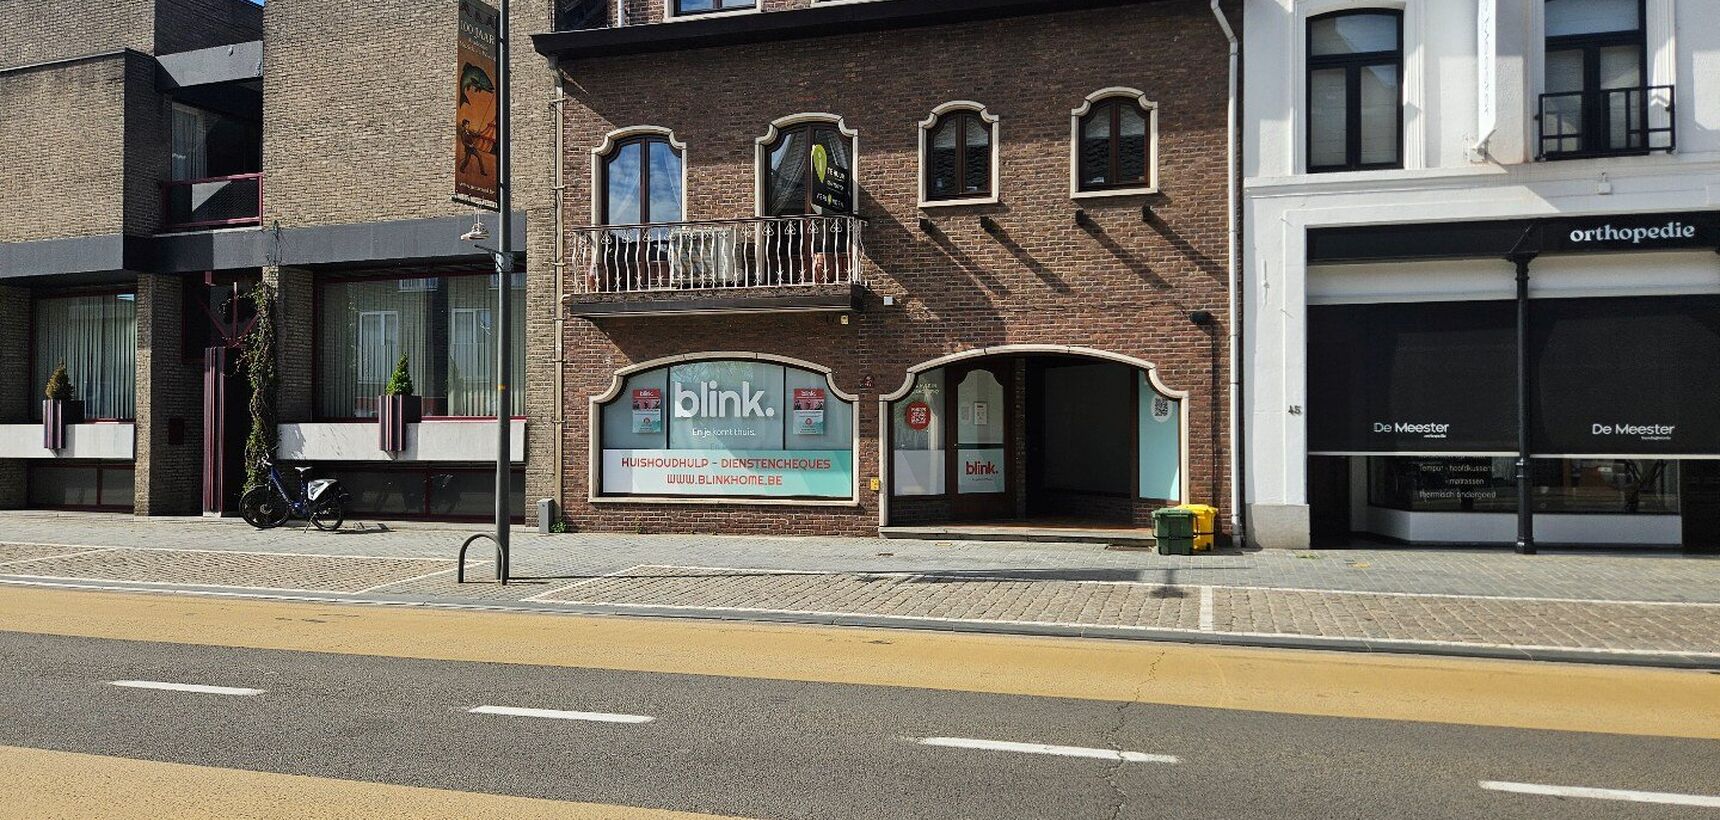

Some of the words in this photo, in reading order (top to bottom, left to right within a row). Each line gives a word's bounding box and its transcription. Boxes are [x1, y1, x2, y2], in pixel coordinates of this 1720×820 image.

[1570, 221, 1696, 244] orthopedie
[674, 380, 775, 418] blink.
[1373, 422, 1392, 433] De
[1395, 422, 1450, 433] Meester
[1592, 423, 1612, 434] De
[1615, 423, 1675, 434] Meester
[621, 457, 709, 468] HUISHOUDHULP
[721, 458, 831, 469] DIENSTENCHEQUES
[965, 460, 999, 475] blink.
[666, 474, 783, 486] WWW.BLINKHOME.BE
